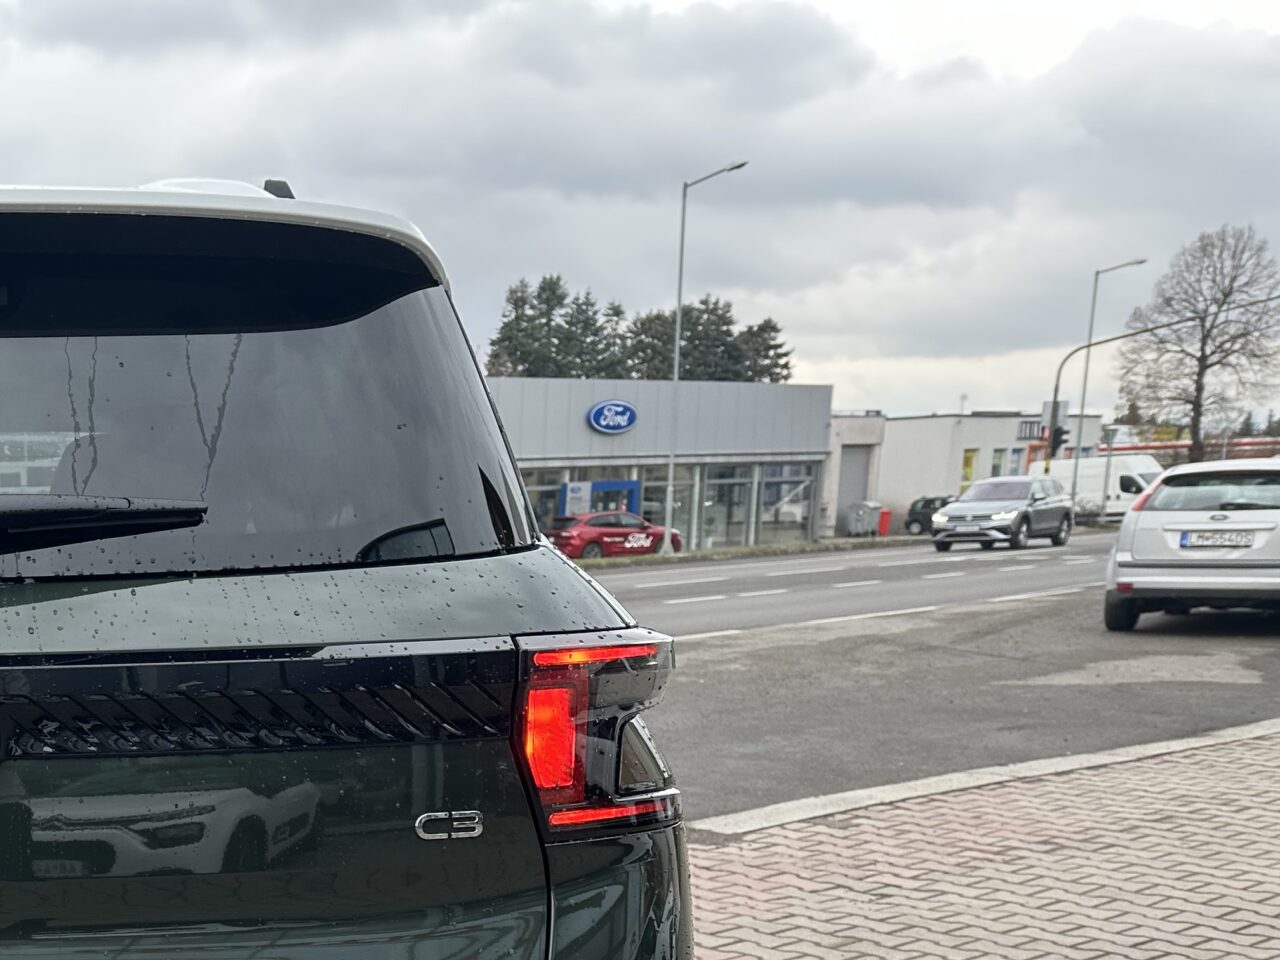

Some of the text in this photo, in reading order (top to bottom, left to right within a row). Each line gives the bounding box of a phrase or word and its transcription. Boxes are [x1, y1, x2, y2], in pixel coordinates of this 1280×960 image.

[599, 404, 631, 427] Ford
[624, 533, 654, 548] Ford
[414, 810, 484, 840] C3
